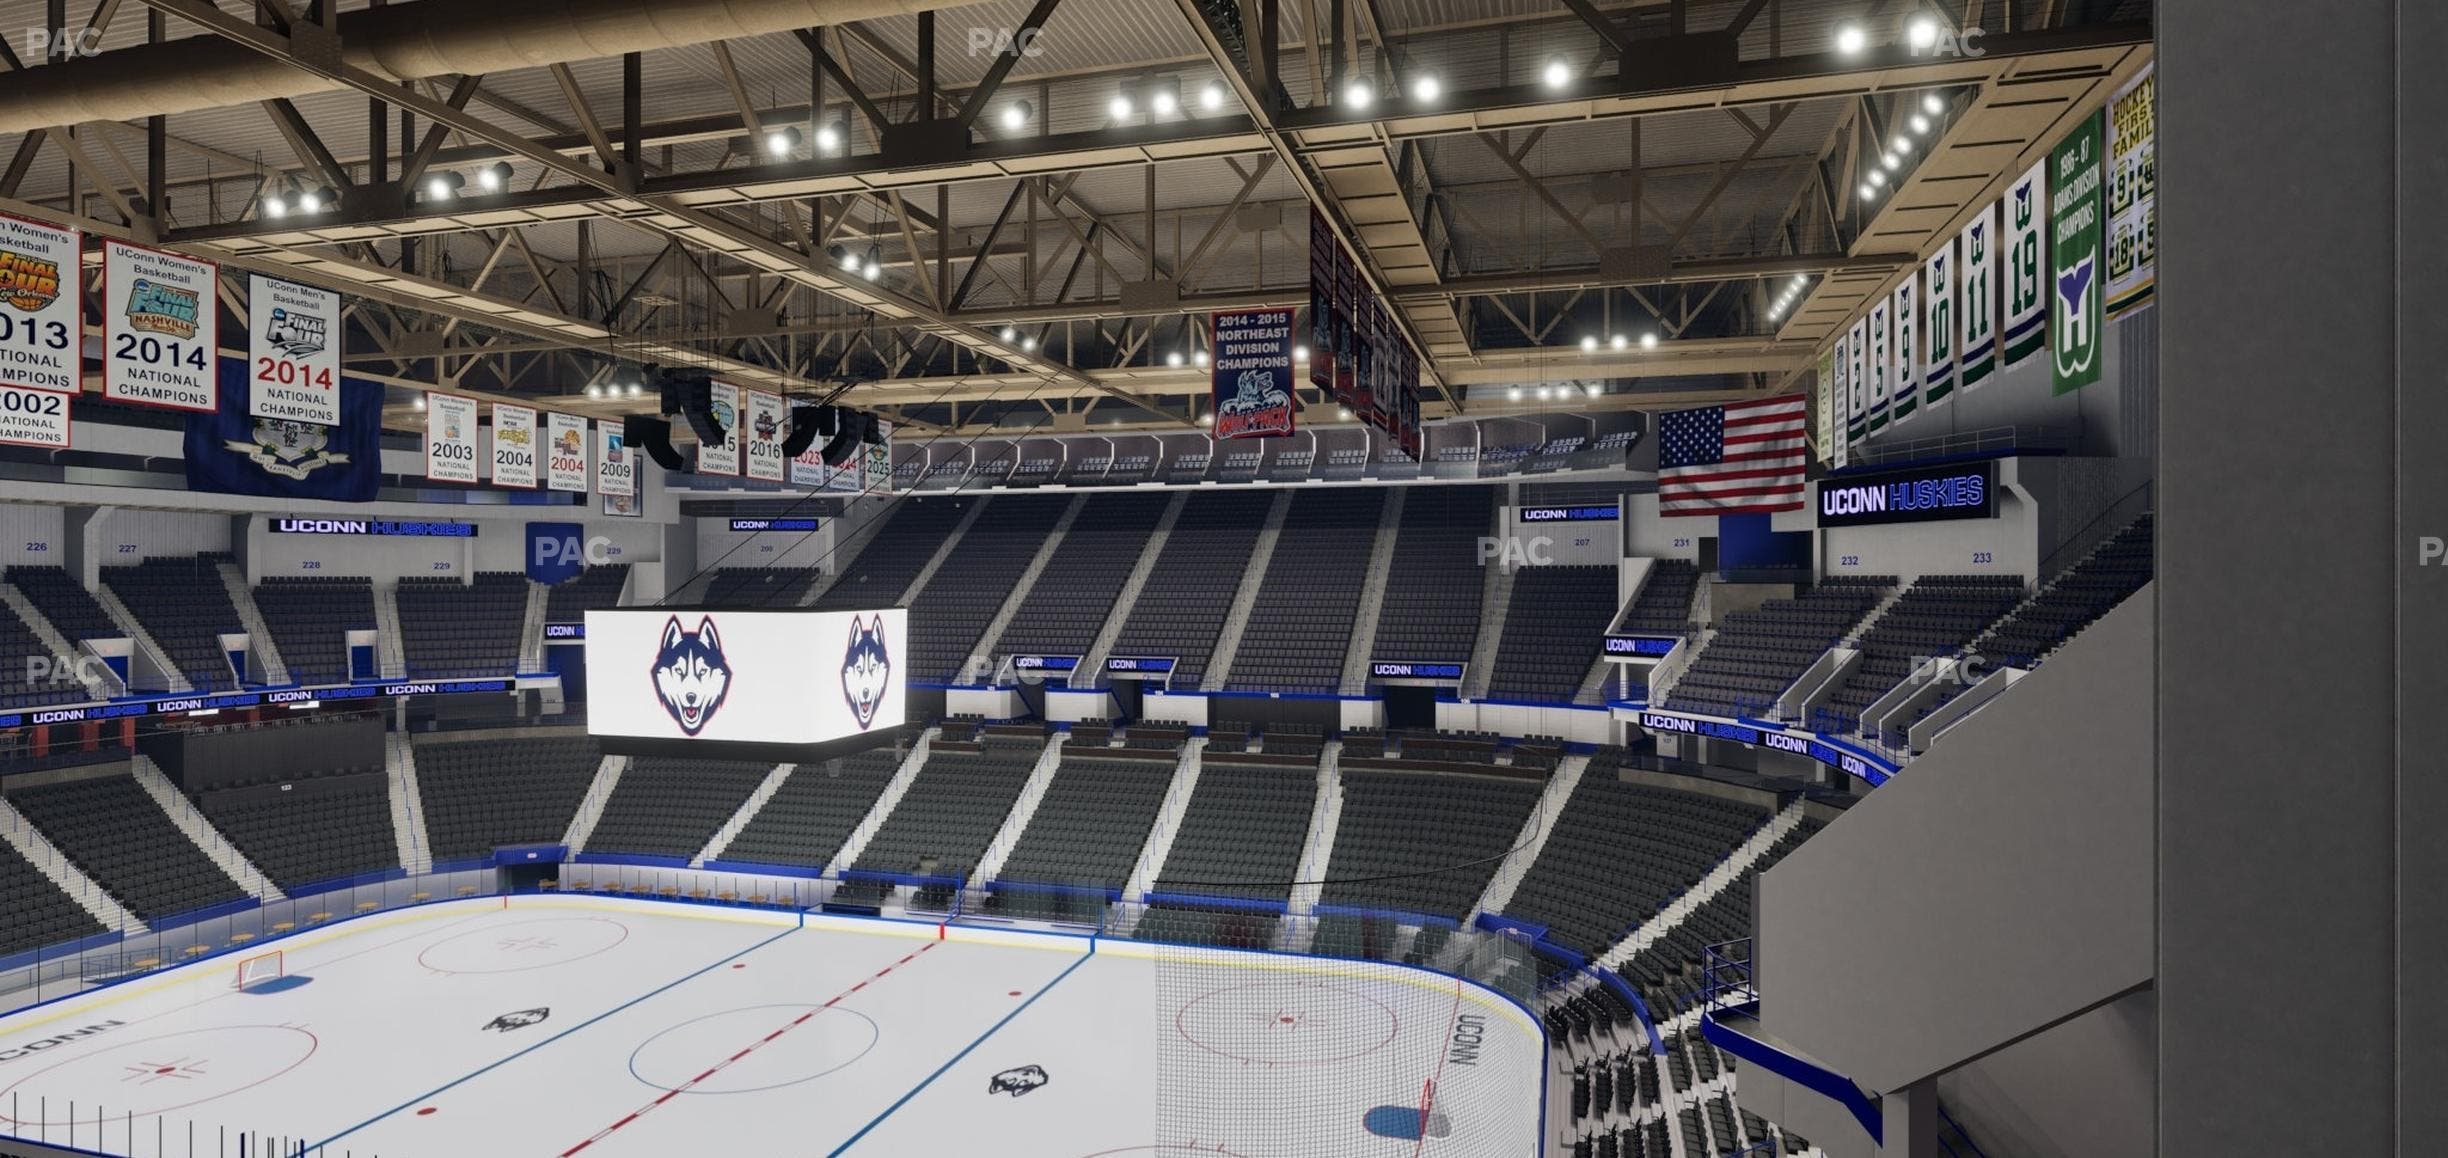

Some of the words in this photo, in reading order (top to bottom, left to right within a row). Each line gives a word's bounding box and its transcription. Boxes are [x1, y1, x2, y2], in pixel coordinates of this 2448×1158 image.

[9, 222, 69, 244] Women's
[116, 246, 155, 263] UConn
[158, 256, 207, 275] Women's
[134, 264, 191, 284] Basketball
[2012, 229, 2037, 317] 19
[267, 280, 298, 294] UConn
[300, 287, 326, 300] Men's
[273, 293, 320, 310] Basketball
[1968, 267, 1988, 343] 11
[135, 315, 191, 331] NASHVILLE
[286, 313, 326, 332] FINAL
[1220, 315, 1248, 327] 2014
[1257, 313, 1286, 325] 2015
[1216, 327, 1289, 341] NORTHEAST
[1932, 297, 1949, 364] 10
[116, 333, 207, 371] 2014
[1226, 342, 1280, 355] DIVISION
[1903, 325, 1910, 382] 9
[1216, 357, 1289, 370] CHAMPIONS
[1876, 345, 1883, 397] 5
[128, 367, 201, 388] NATIONAL
[257, 356, 333, 391] 2014
[1855, 362, 1861, 409] 2
[119, 383, 208, 405] CHAMPIONS
[267, 388, 328, 405] NATIONAL
[0, 391, 60, 416] 002
[260, 402, 334, 421] CHAMPIONS
[0, 415, 56, 430] ATIONAL
[432, 442, 473, 460] 2003
[705, 452, 733, 462] NATIONAL
[750, 440, 780, 459] 2016
[437, 461, 470, 470] NATIONAL
[497, 450, 533, 467] 2004
[551, 456, 584, 473] 2004
[434, 470, 473, 480] CHAMPIONS
[600, 462, 631, 478] 2009
[703, 462, 736, 473] CHAMPIONS
[867, 460, 889, 476] 2025
[1824, 485, 1886, 515] UCONN
[1889, 475, 1983, 511] HUSKIES
[1525, 510, 1567, 519] UCONN
[280, 519, 366, 533] UCONN
[371, 521, 471, 536] HUSKIES
[733, 520, 769, 529] UCONN
[26, 542, 48, 551] 226
[118, 544, 137, 552] 227
[1674, 538, 1690, 547] 231
[434, 562, 450, 570] 229
[1841, 556, 1859, 566] 232
[1973, 552, 1992, 564] 233
[547, 626, 575, 636] UCONN
[1606, 638, 1635, 652] UCONN
[1016, 657, 1043, 667] UCONN
[1109, 659, 1137, 669] UCONN
[1375, 665, 1411, 675] UCONN
[268, 690, 312, 703] UCONN
[385, 683, 436, 695] UCONN
[157, 699, 201, 712] UCONN
[33, 710, 84, 723] UCONN
[1644, 716, 1695, 733] UCONN
[1765, 733, 1807, 754] UCONN
[1449, 1014, 1487, 1067] UCONN
